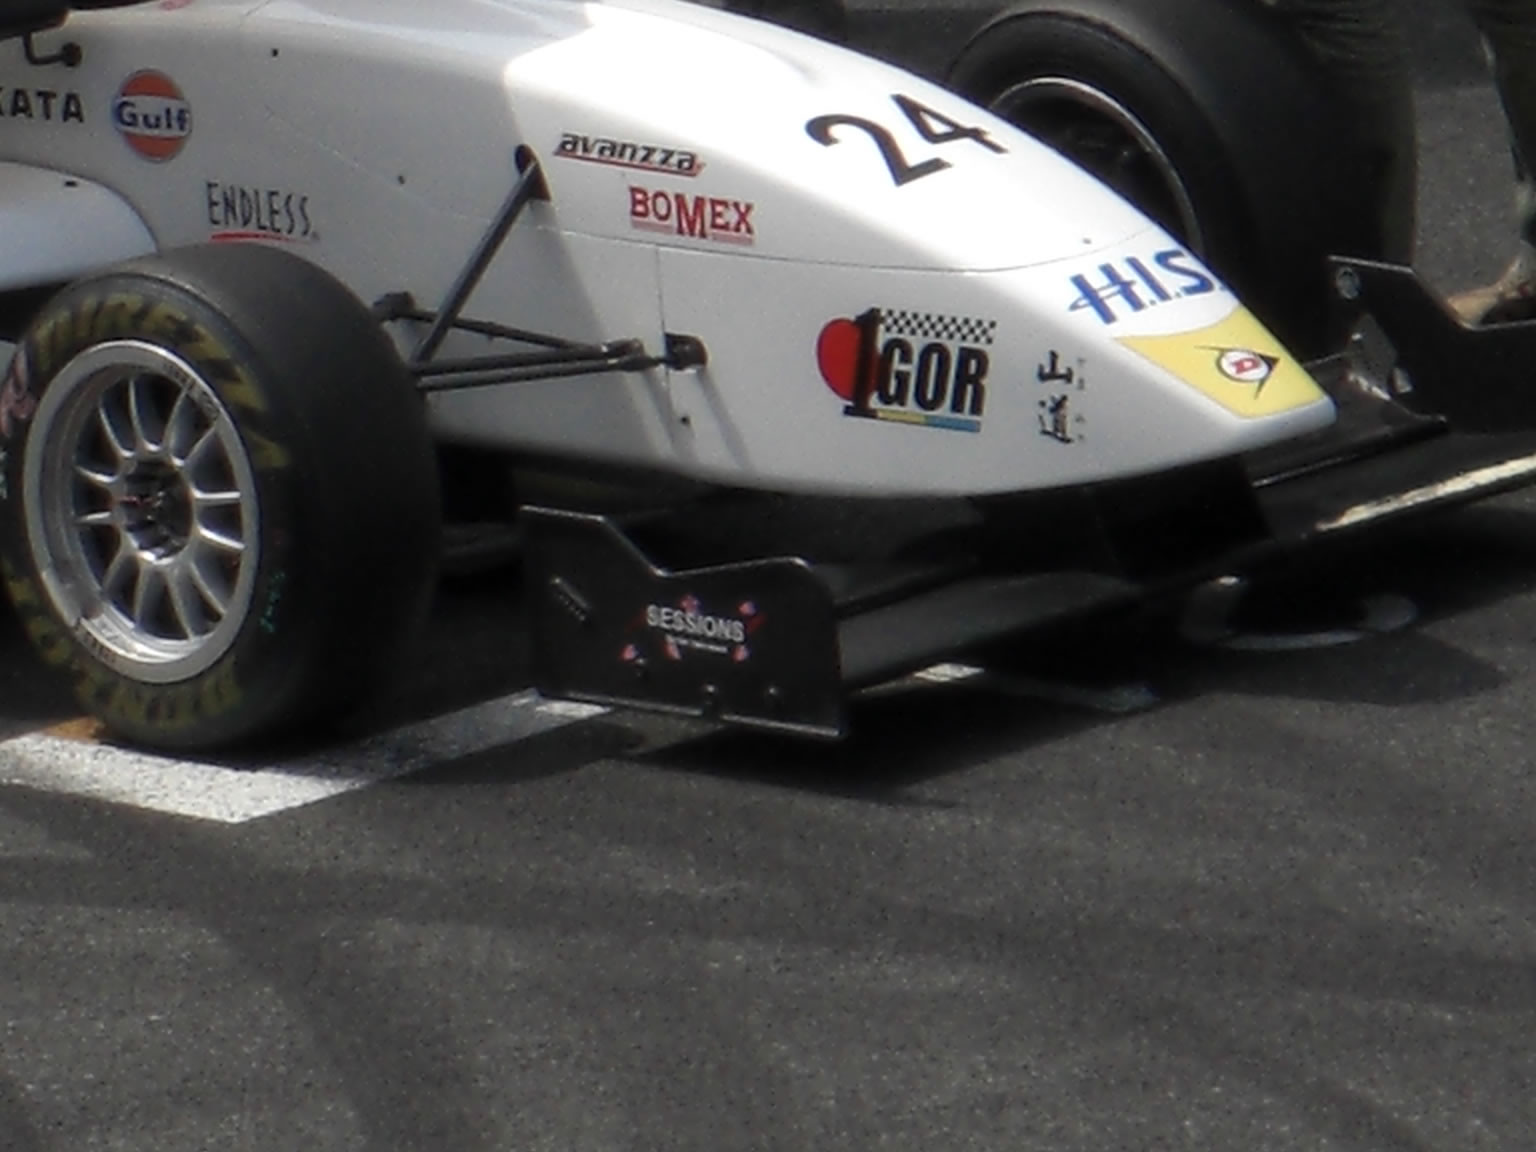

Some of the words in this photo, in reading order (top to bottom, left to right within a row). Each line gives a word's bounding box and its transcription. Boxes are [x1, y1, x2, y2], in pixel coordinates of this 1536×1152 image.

[116, 100, 191, 133] Gulf
[804, 93, 1011, 187] 24
[560, 132, 699, 173] avanzza
[206, 180, 315, 238] ENDLESS
[629, 185, 756, 239] BOMEX
[646, 604, 746, 644] SESSIONS
